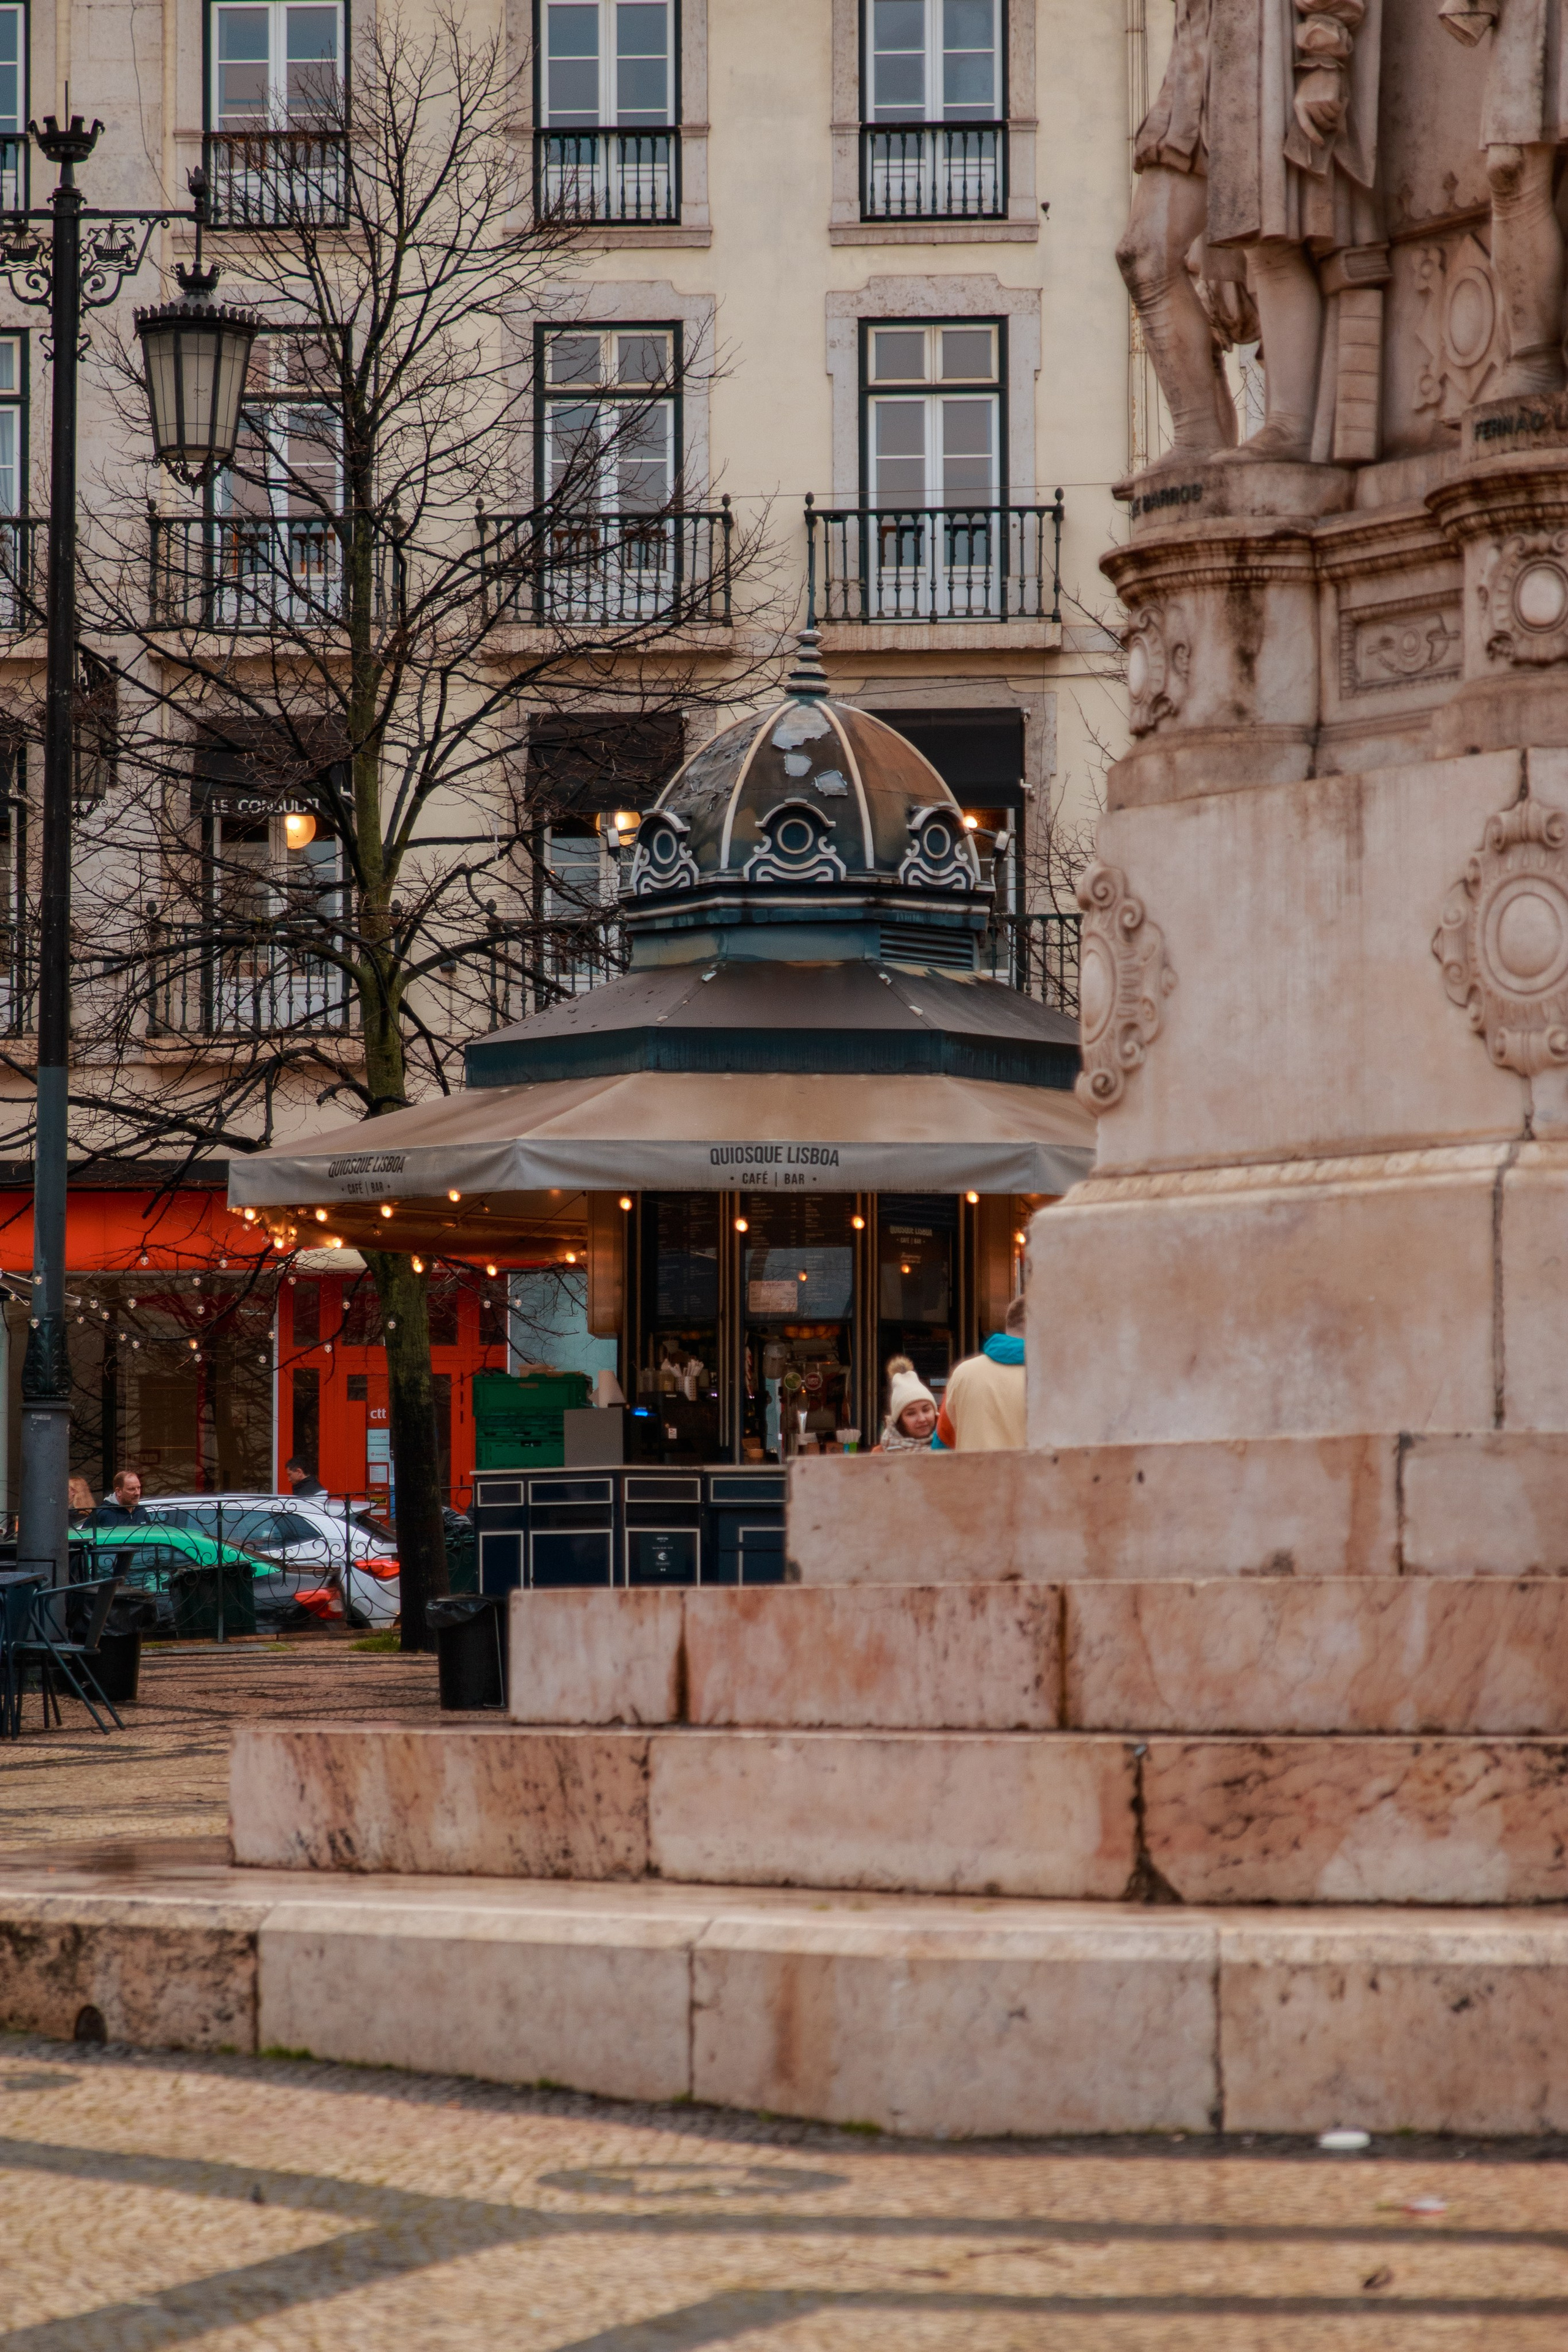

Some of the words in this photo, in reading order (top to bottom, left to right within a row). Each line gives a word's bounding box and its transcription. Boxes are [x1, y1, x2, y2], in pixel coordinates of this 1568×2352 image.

[212, 799, 229, 813] LE
[710, 1146, 783, 1166] QUIOSQUE
[787, 1147, 839, 1167] LISBOA
[328, 1156, 374, 1178] QUIOSQUE
[372, 1156, 405, 1174] LISBOA
[742, 1171, 768, 1184] CAFÉ
[785, 1174, 805, 1185] BAR
[347, 1181, 363, 1194] CAFÉ
[371, 1182, 383, 1193] BAR
[370, 1408, 386, 1419] ctt
